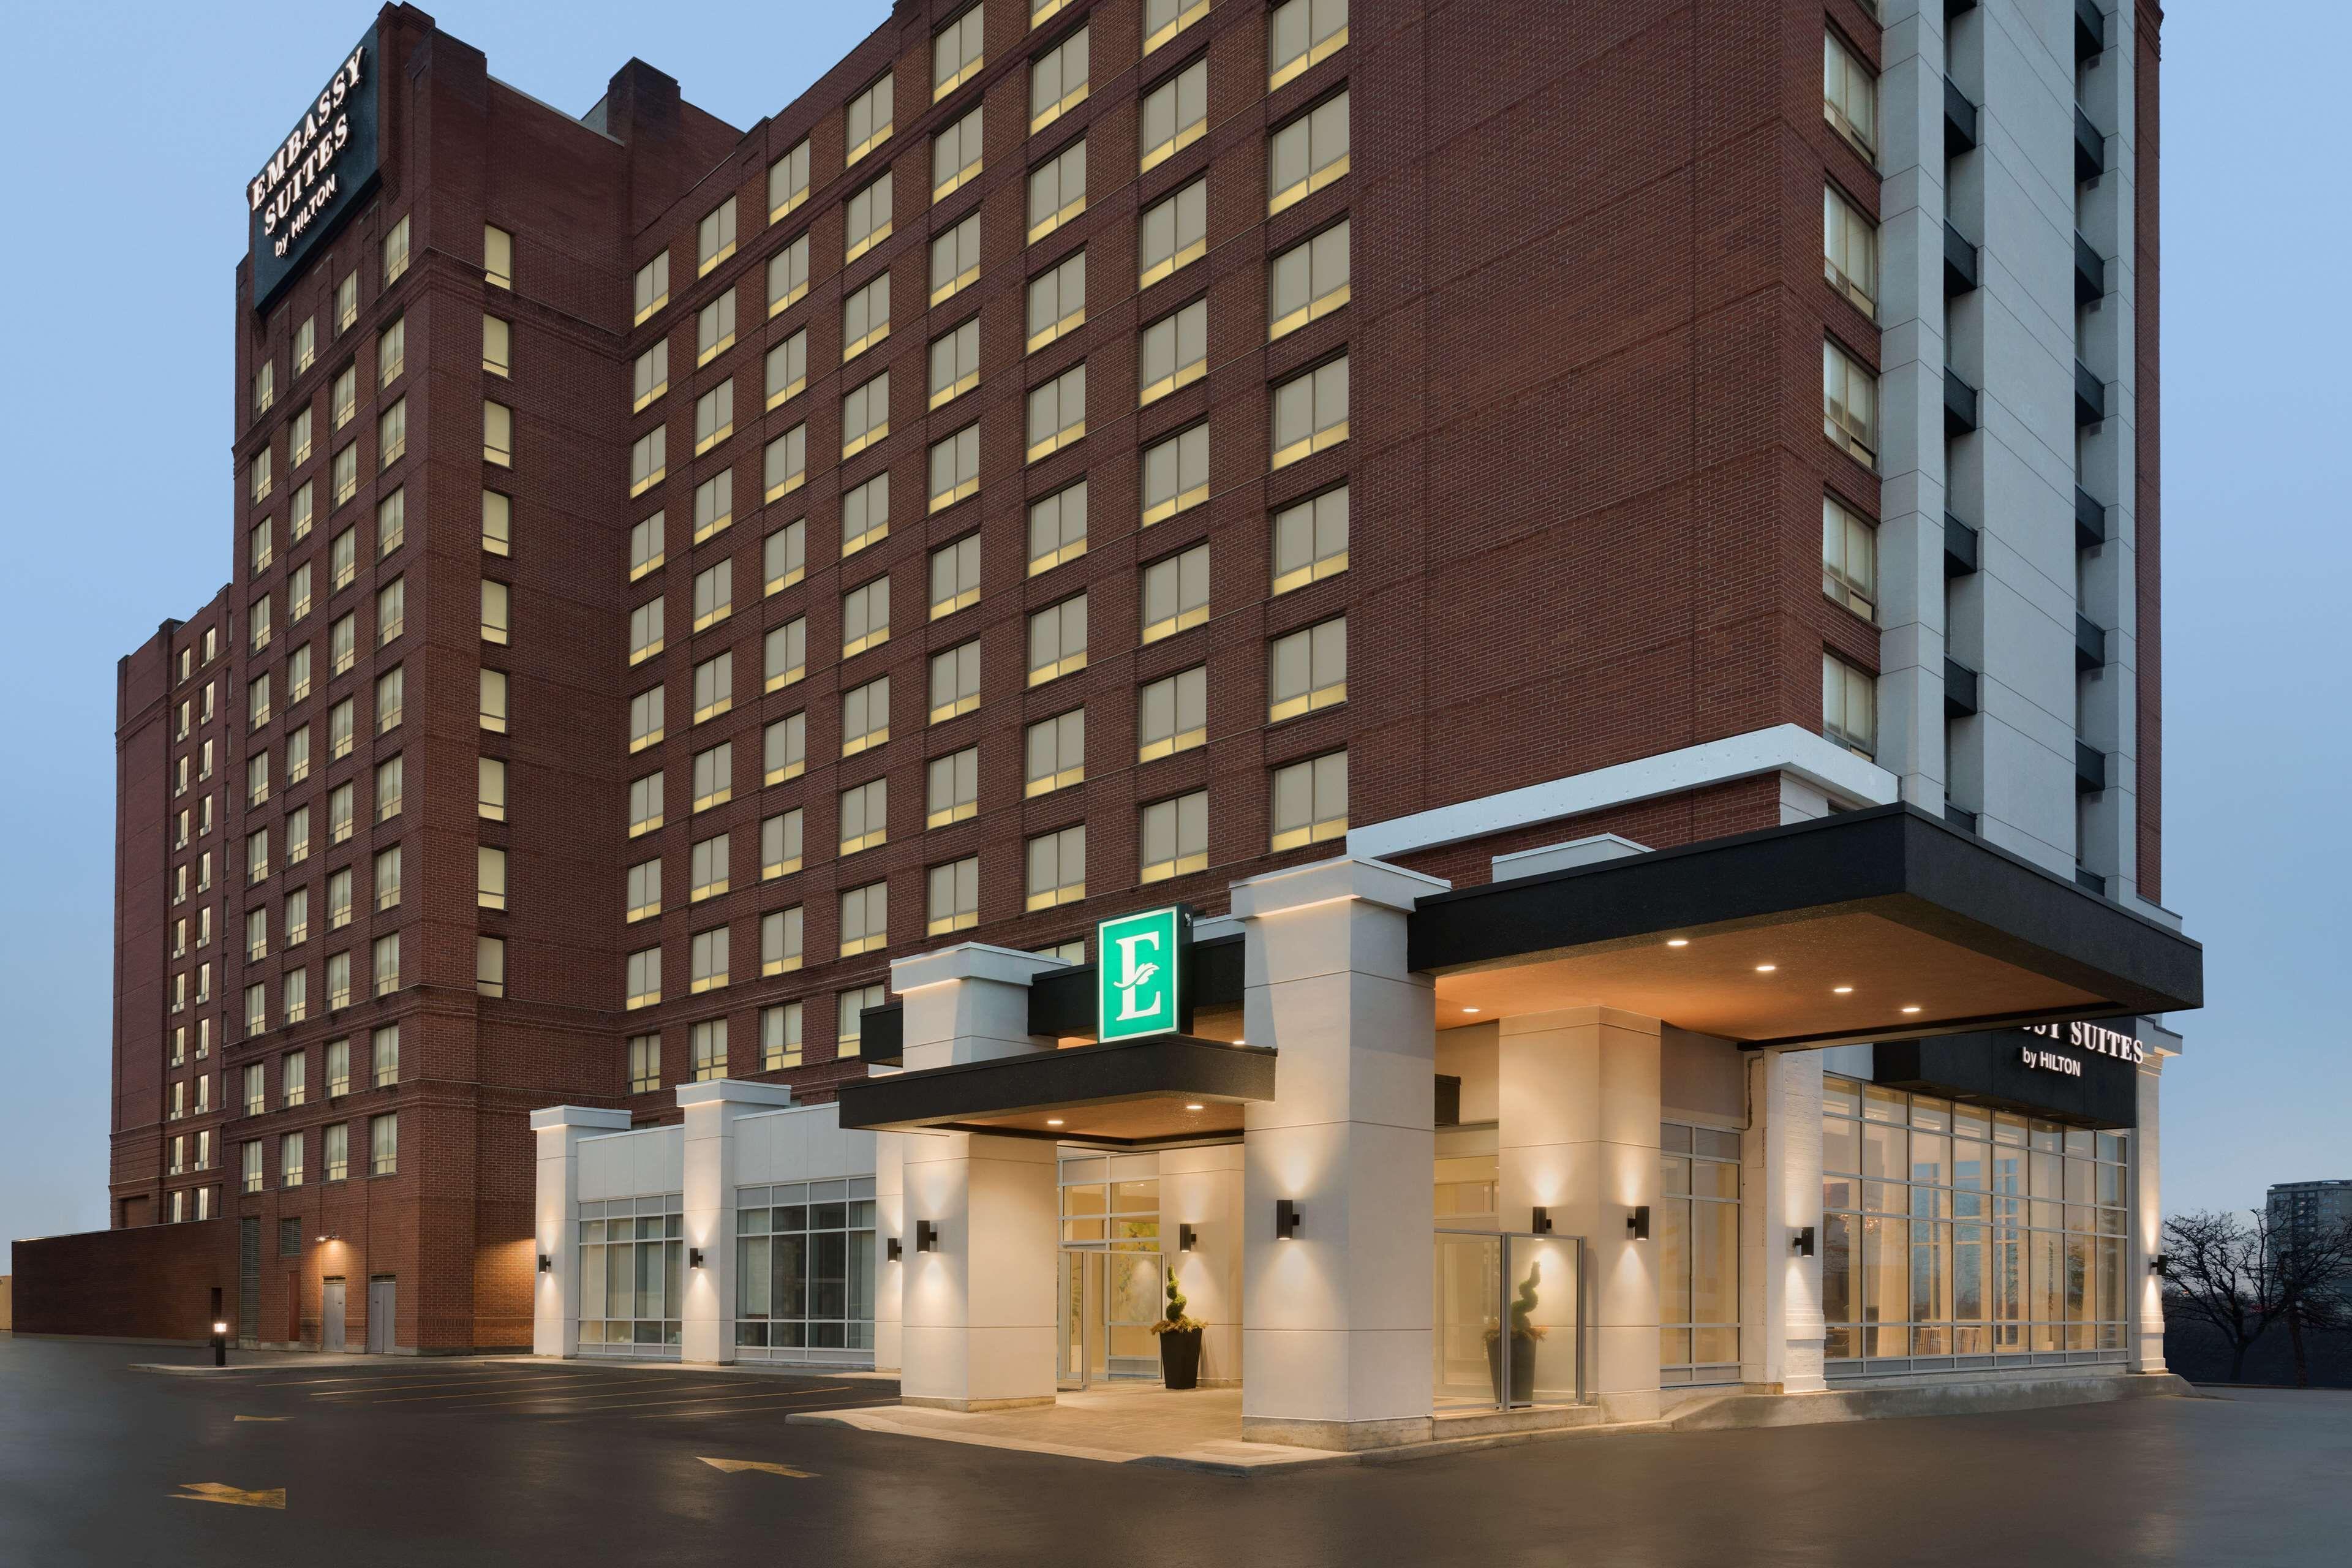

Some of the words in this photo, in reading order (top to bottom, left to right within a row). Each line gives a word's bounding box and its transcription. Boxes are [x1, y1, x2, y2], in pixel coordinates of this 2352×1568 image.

[252, 46, 363, 211] EMBASSY
[264, 114, 347, 236] SUITES
[275, 233, 288, 257] by
[291, 174, 336, 238] HILTON
[1113, 930, 1161, 1021] E
[2022, 1046, 2037, 1068] by
[2040, 1051, 2081, 1077] HILTON
[2070, 1021, 2143, 1065] SUITES
